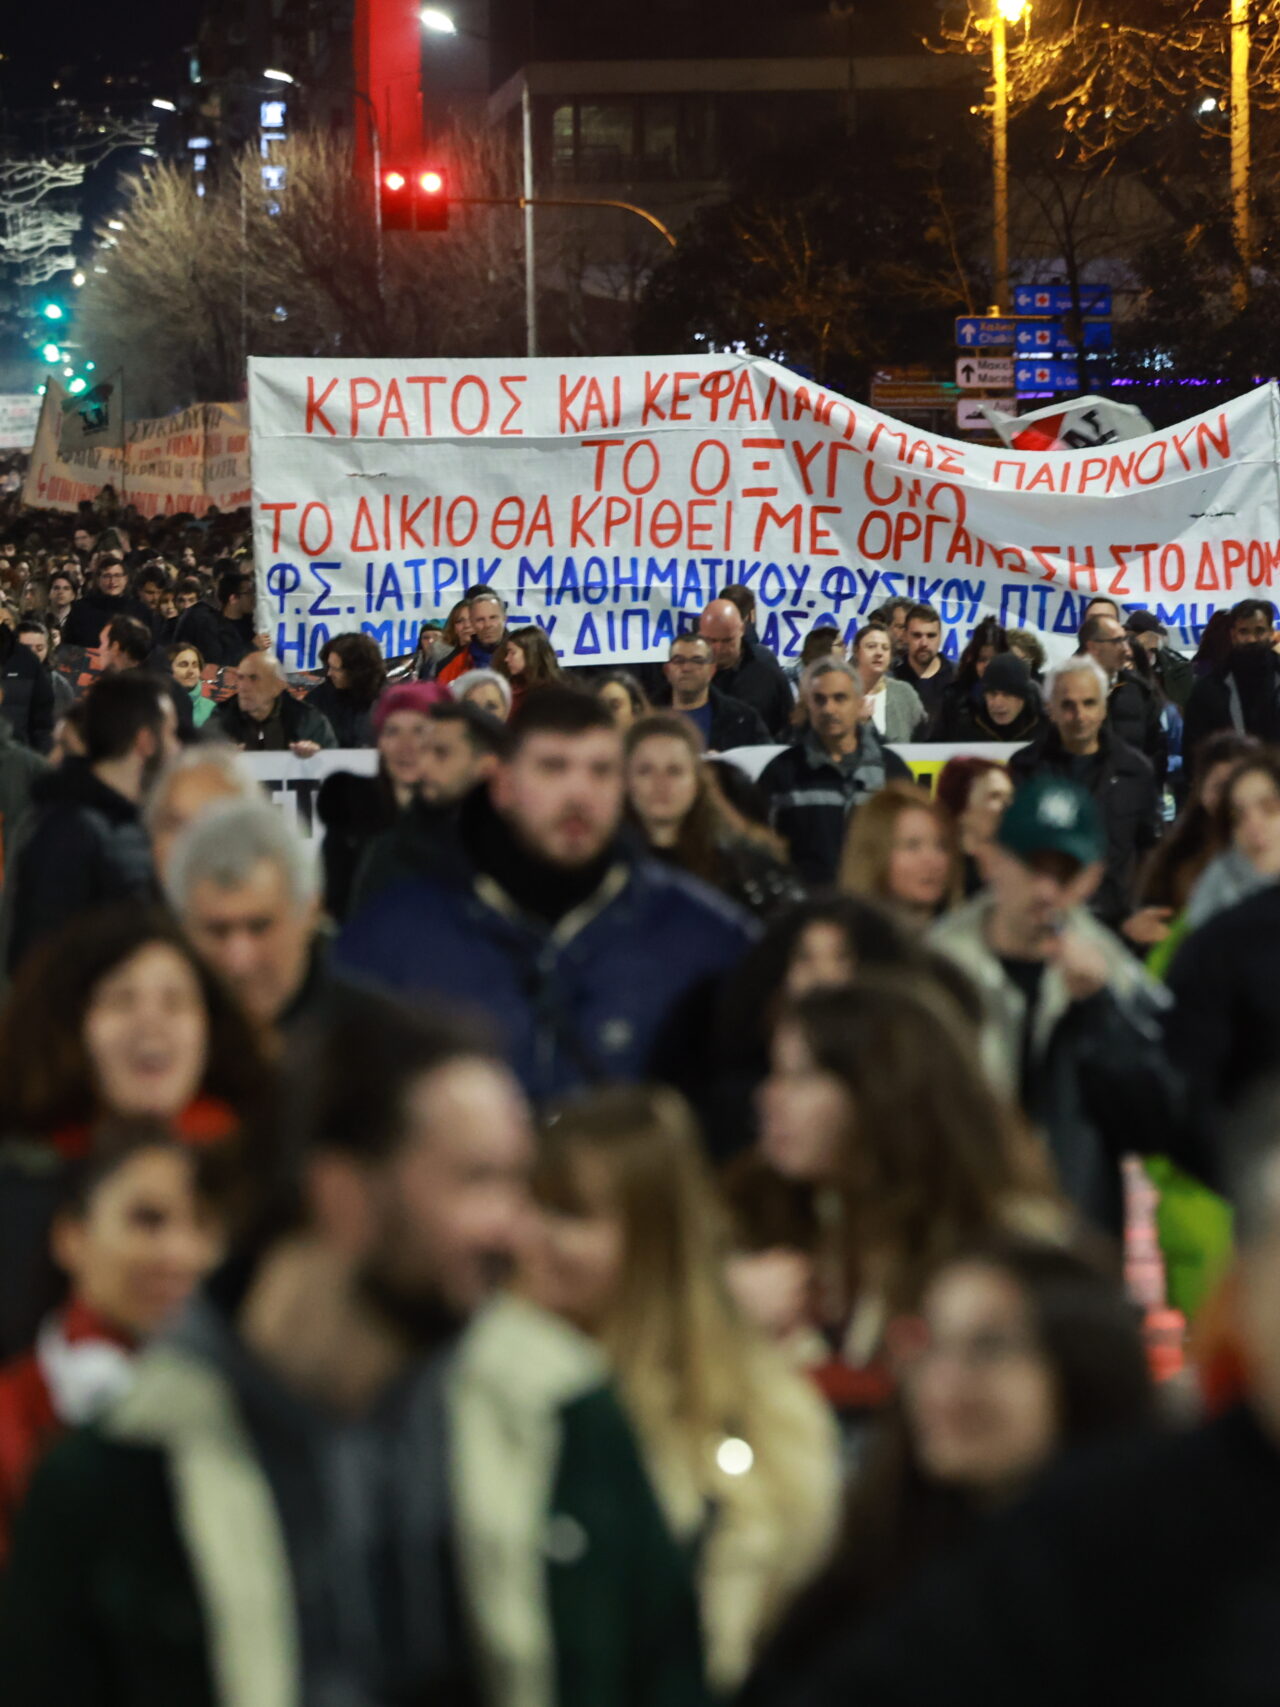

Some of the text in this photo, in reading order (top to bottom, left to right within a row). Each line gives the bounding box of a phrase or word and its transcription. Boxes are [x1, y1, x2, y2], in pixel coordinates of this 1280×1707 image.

[305, 374, 528, 438] ΚΡΑΤΟΣ
[559, 374, 621, 432] ΚΑΙ
[867, 423, 966, 475] ΜΑΣ
[994, 413, 1231, 494] ΠΑΙΡΝΟΥΝ
[581, 438, 661, 496] ΤΟ
[260, 502, 333, 556] ΤΟ
[350, 494, 479, 552] ΔΙΚΙΟ
[491, 494, 554, 550] ΘΑ
[570, 496, 732, 551] ΚΡΙΘΕΙ
[753, 503, 842, 556] ΜΕ
[1108, 543, 1186, 595] ΣΤΟ
